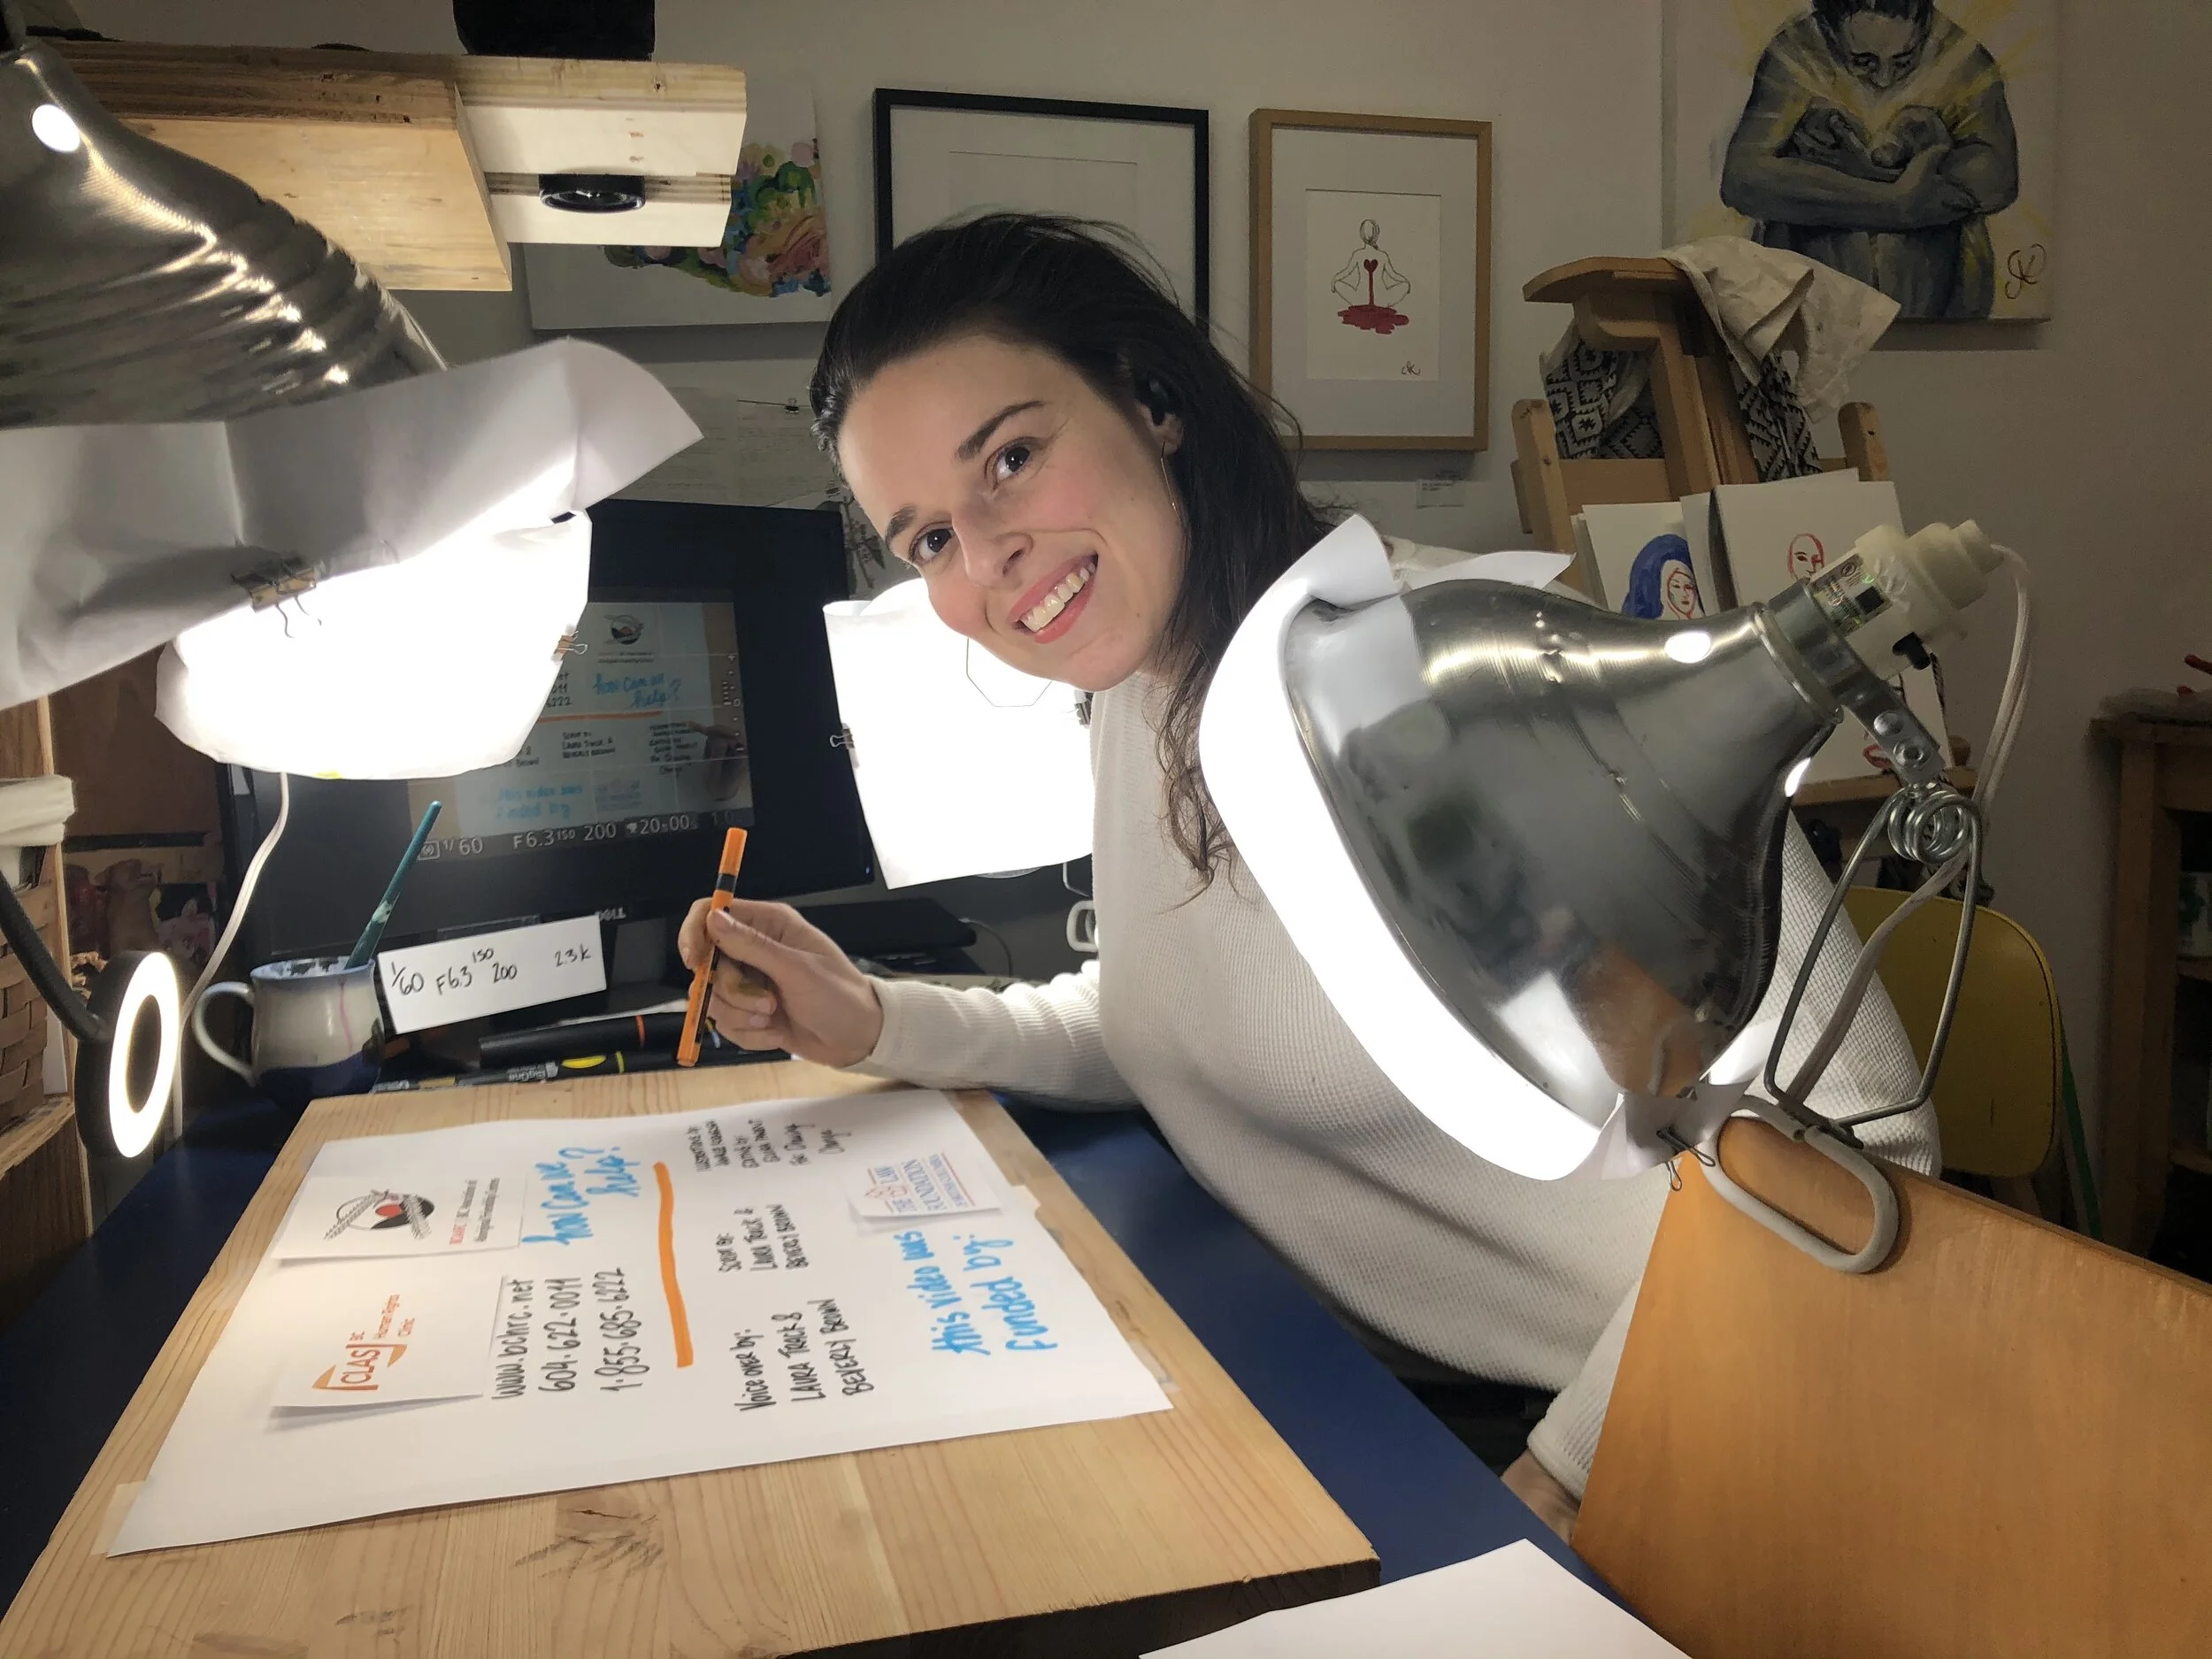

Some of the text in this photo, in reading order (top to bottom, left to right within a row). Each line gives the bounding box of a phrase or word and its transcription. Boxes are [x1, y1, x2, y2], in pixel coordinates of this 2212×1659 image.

[512, 829, 555, 849] F6.3
[583, 823, 617, 841] 200
[391, 961, 425, 995] 1/60
[435, 964, 472, 995] F6.3
[492, 962, 518, 984] 200
[906, 1265, 963, 1310] video
[491, 1279, 534, 1400] www.bchrc.net
[807, 1298, 875, 1396] BEVERLY BROWN
[340, 1349, 381, 1385] CLAS
[787, 1362, 826, 1402] LAURA
[733, 1379, 777, 1412] Voice
